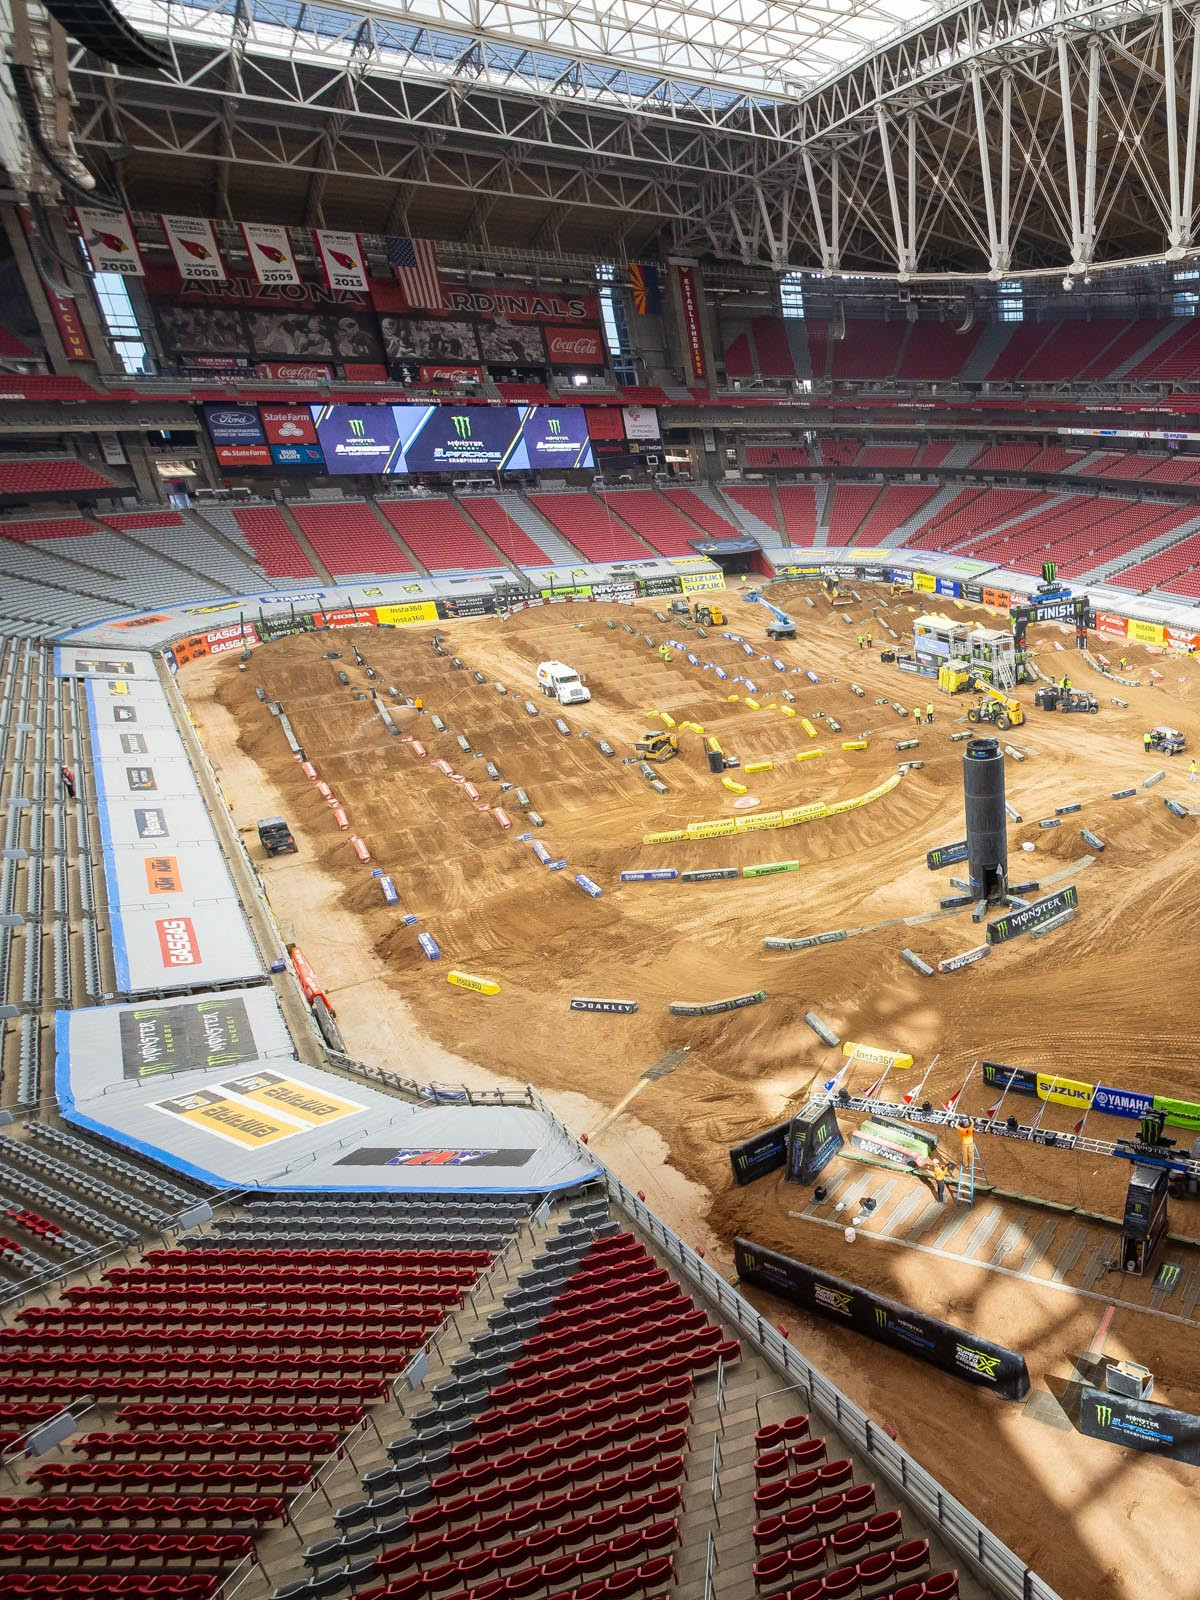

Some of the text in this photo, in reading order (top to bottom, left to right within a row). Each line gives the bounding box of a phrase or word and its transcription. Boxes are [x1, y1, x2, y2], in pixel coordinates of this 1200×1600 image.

[101, 262, 137, 273] 2008
[186, 267, 219, 278] 2008
[263, 272, 294, 282] 2009
[334, 277, 363, 288] 2015
[180, 277, 367, 305] ARIZONA
[551, 337, 597, 354] Coca-Cola
[219, 413, 247, 425] Ford
[265, 413, 309, 421] State Farm
[683, 574, 722, 583] SUZUKI
[685, 582, 725, 591] SUZUKI
[279, 593, 320, 602] YAMAHA
[390, 605, 422, 613] Insta360
[1037, 603, 1075, 620] FINISH
[333, 612, 370, 620] HONDA
[393, 615, 424, 624] Insta360
[207, 626, 252, 642] GASGAS
[1136, 624, 1156, 633] Insta360
[1136, 634, 1156, 642] Insta360
[211, 637, 256, 653] GASGAS
[744, 815, 781, 824] DUNLOP
[792, 813, 825, 824] DUNLOP
[696, 822, 733, 831] DUNLOP
[746, 822, 782, 832] DUNLOP
[653, 834, 686, 844] DUNLOP
[700, 829, 734, 838] DUNLOP
[152, 859, 172, 872] KTM
[755, 865, 789, 876] Kawasaki
[155, 877, 176, 891] KTM
[1011, 898, 1061, 927] MONSTER
[164, 920, 194, 964] GASGAS
[456, 976, 482, 991] Insta360
[588, 1002, 632, 1012] OAKLEY
[203, 1011, 227, 1053] MONSTER
[226, 1016, 239, 1043] ENERGY
[138, 1020, 162, 1062] MONSTER
[164, 1024, 175, 1053] ENERGY
[856, 1049, 894, 1066] Insta360
[1039, 1081, 1091, 1101] SUZUKI
[264, 1087, 339, 1116] EMPIRE
[1108, 1094, 1150, 1111] YAMAHA
[202, 1106, 280, 1138] EMPIRE
[1129, 1142, 1171, 1156] MONSTER
[815, 1286, 835, 1298] SUPER
[956, 1346, 979, 1360] SUPER
[957, 1351, 978, 1363] MOTO
[955, 1355, 978, 1368] CROSS
[1125, 1414, 1160, 1429] MONSTER
[1111, 1420, 1175, 1443] SUPERCROSS
[1124, 1429, 1160, 1443] CHAMPIONSHIP
